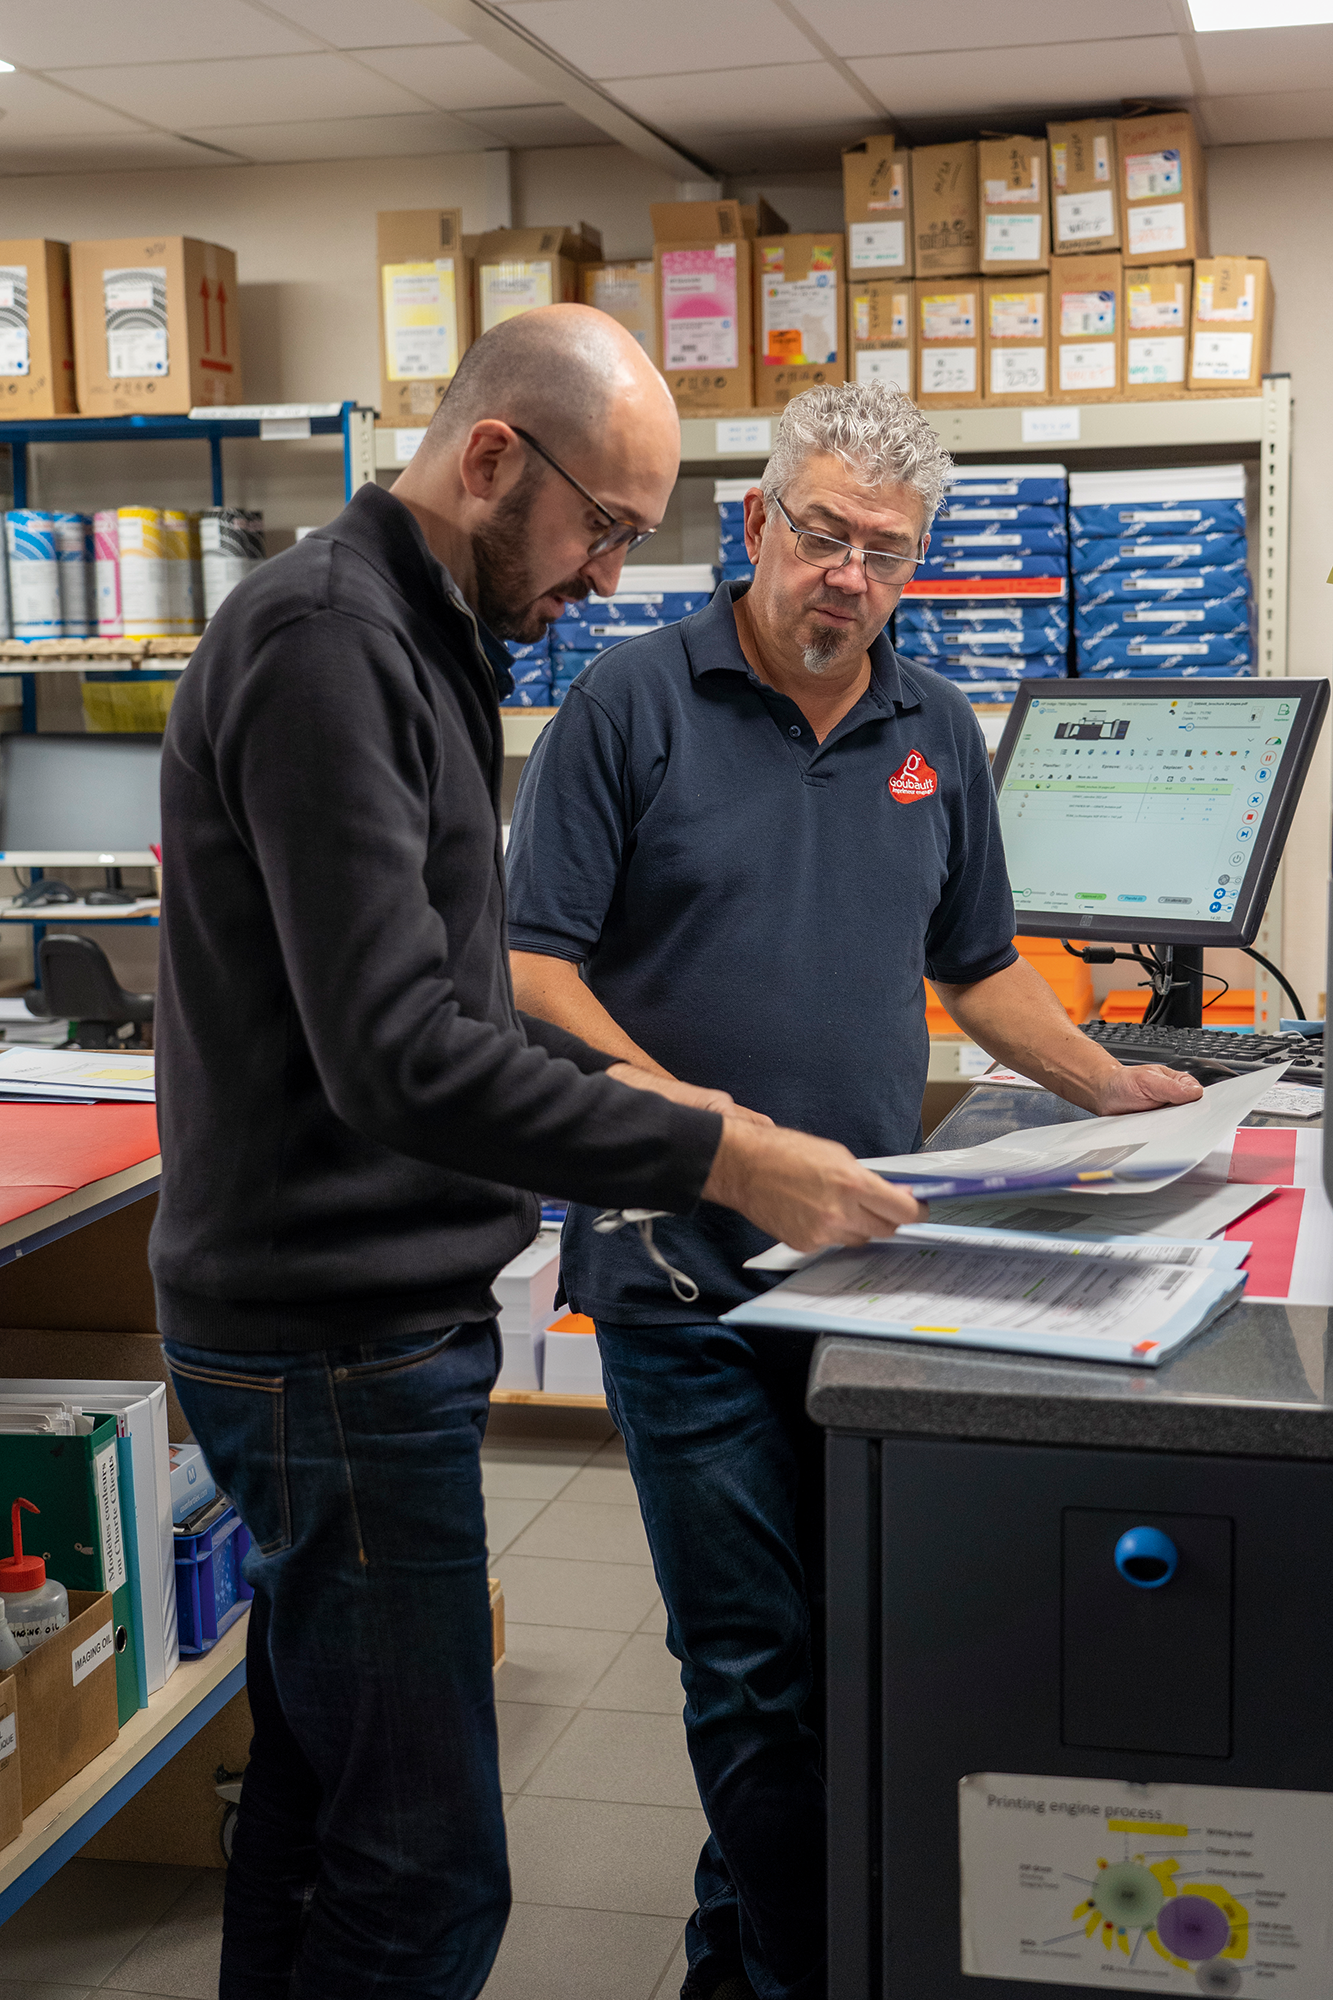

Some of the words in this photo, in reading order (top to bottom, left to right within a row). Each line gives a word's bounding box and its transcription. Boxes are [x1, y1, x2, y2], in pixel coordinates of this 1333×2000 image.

[889, 777, 934, 790] Goubault
[102, 1462, 110, 1521] couleurs
[108, 1455, 118, 1504] Clients
[112, 1508, 122, 1556] Charte
[106, 1524, 115, 1582] Modèles
[117, 1558, 123, 1576] ou
[74, 1642, 101, 1672] IMAGING
[101, 1634, 113, 1649] OIL
[0, 1733, 14, 1750] QUE
[987, 1794, 1046, 1814] Printing
[1050, 1800, 1100, 1817] engine
[1104, 1805, 1163, 1820] process
